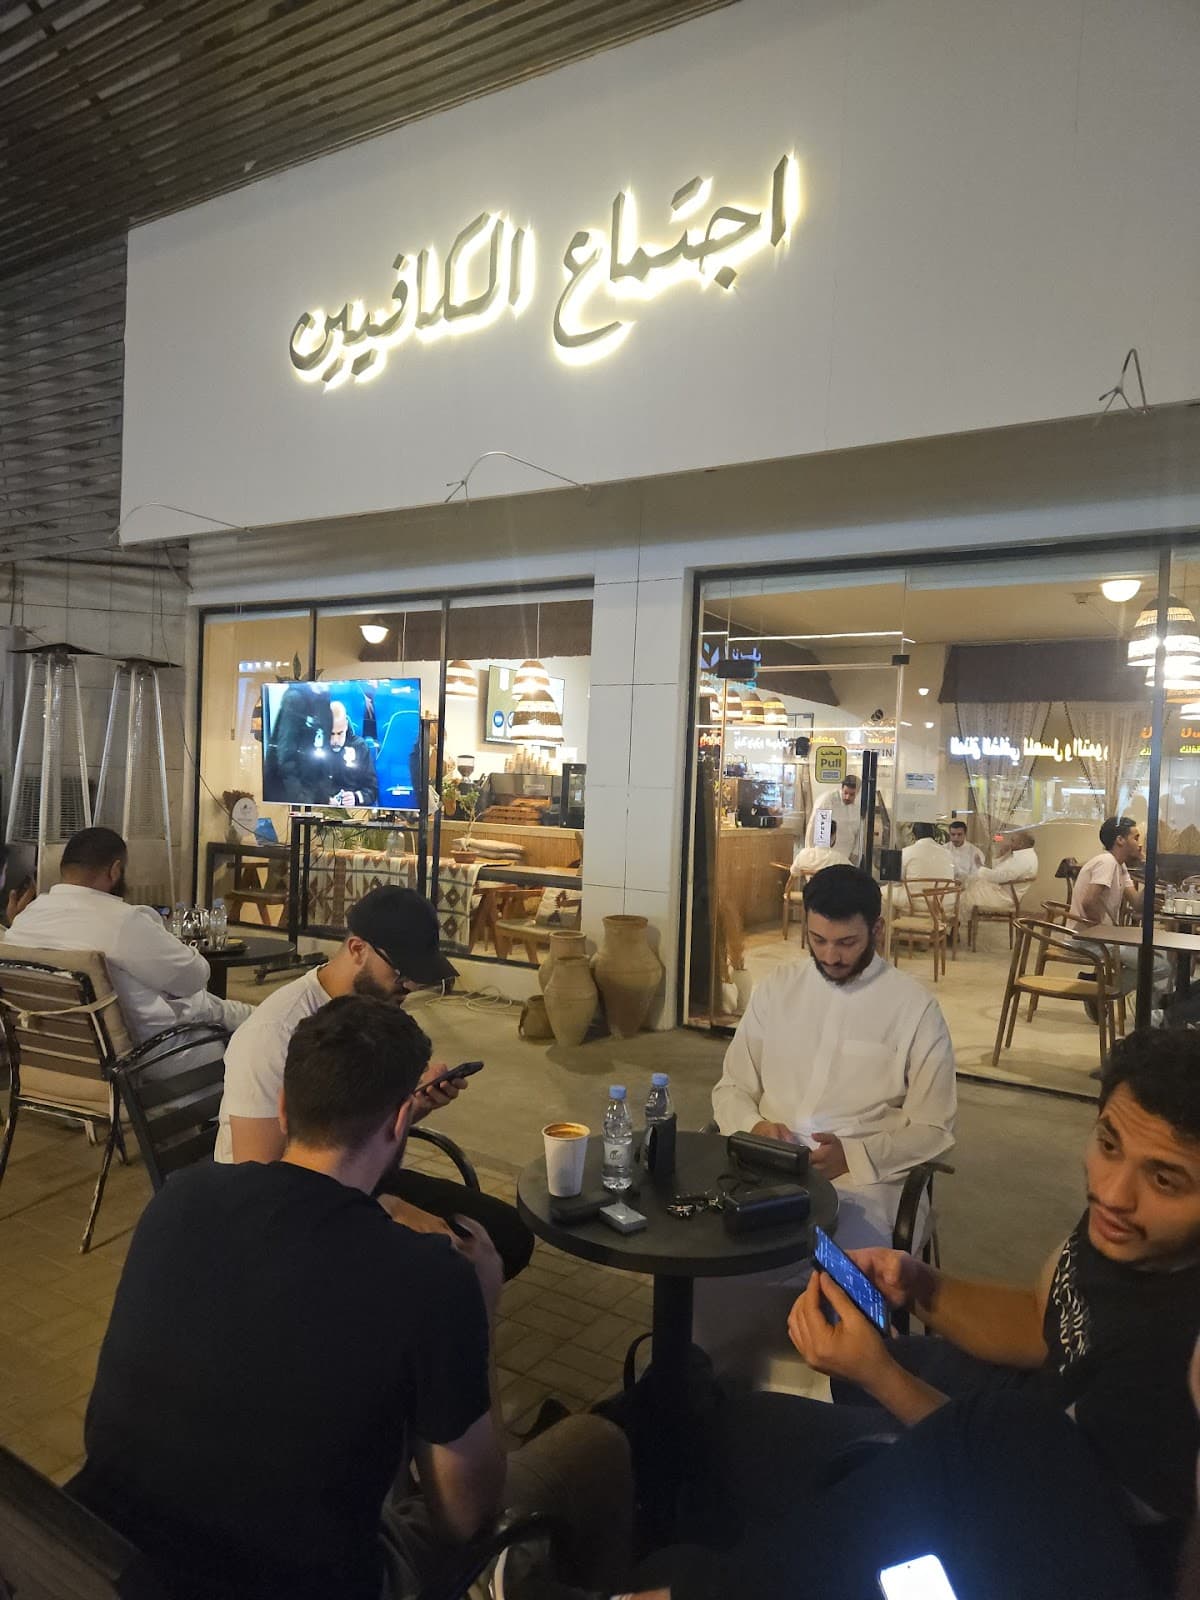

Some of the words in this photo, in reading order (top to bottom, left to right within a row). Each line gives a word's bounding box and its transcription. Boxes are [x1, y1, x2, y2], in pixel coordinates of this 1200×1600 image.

[289, 210, 527, 383] الكافيين
[553, 153, 792, 350] اجتماع
[820, 758, 842, 768] Pull
